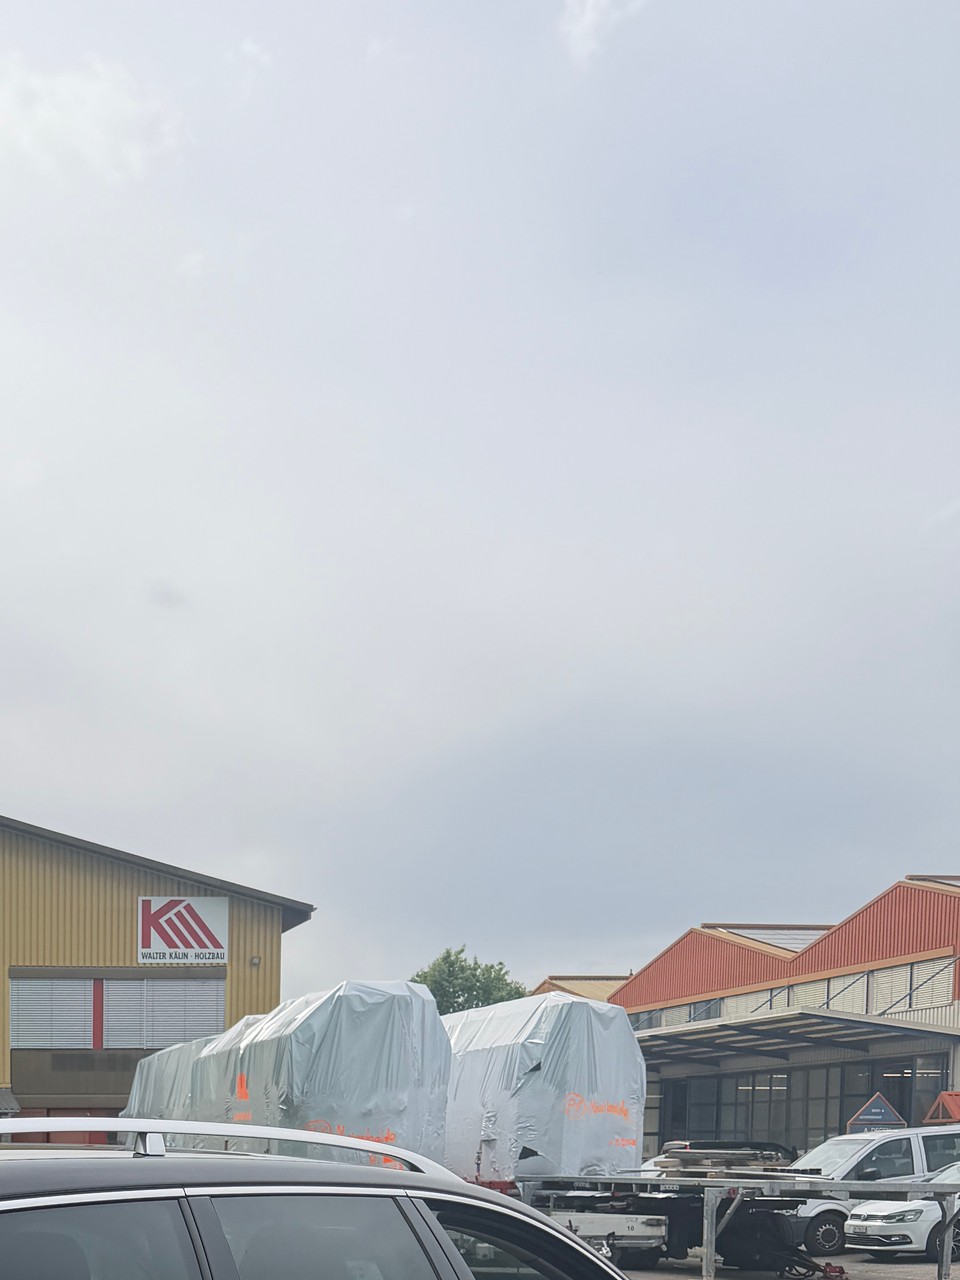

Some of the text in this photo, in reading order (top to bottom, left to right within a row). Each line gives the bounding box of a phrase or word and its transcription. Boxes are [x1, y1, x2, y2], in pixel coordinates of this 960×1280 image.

[141, 950, 225, 960] WALTER KÄLIN HOLZBAU
